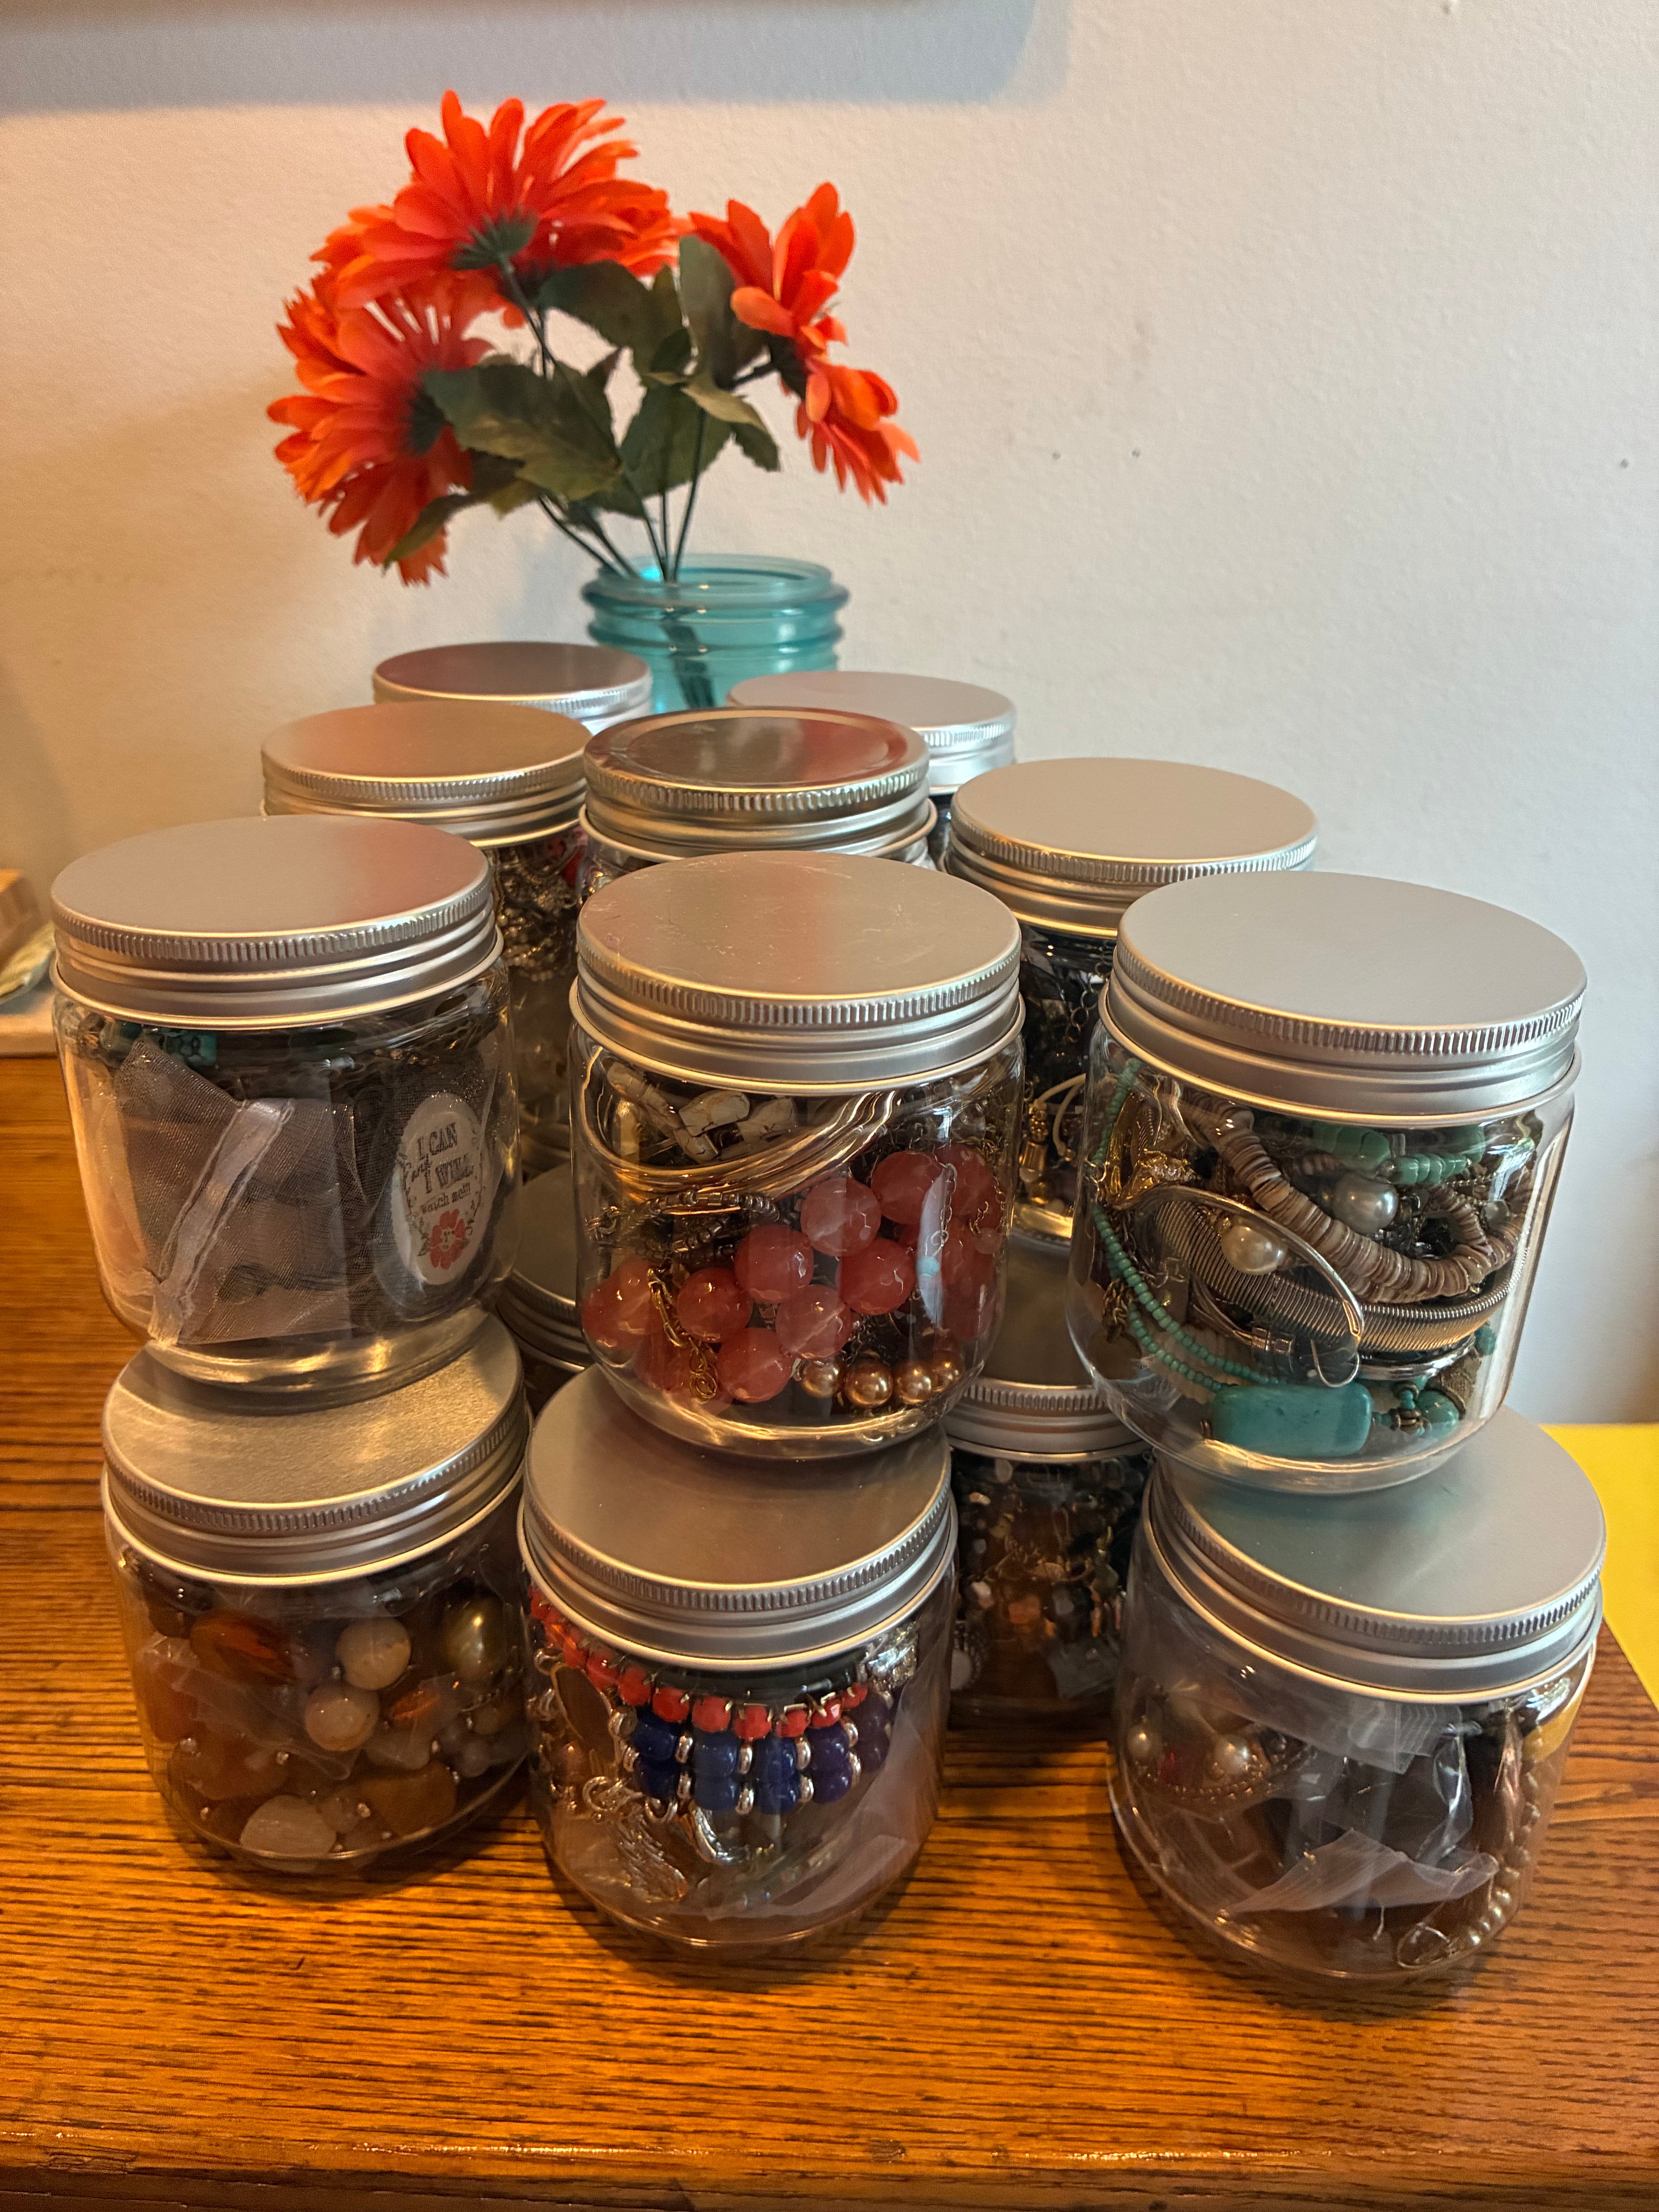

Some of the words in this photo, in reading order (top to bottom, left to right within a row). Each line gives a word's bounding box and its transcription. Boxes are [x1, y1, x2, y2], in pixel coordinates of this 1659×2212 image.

[417, 1136, 426, 1160] I
[429, 1122, 458, 1155] CAN
[435, 1153, 474, 1188] WILL
